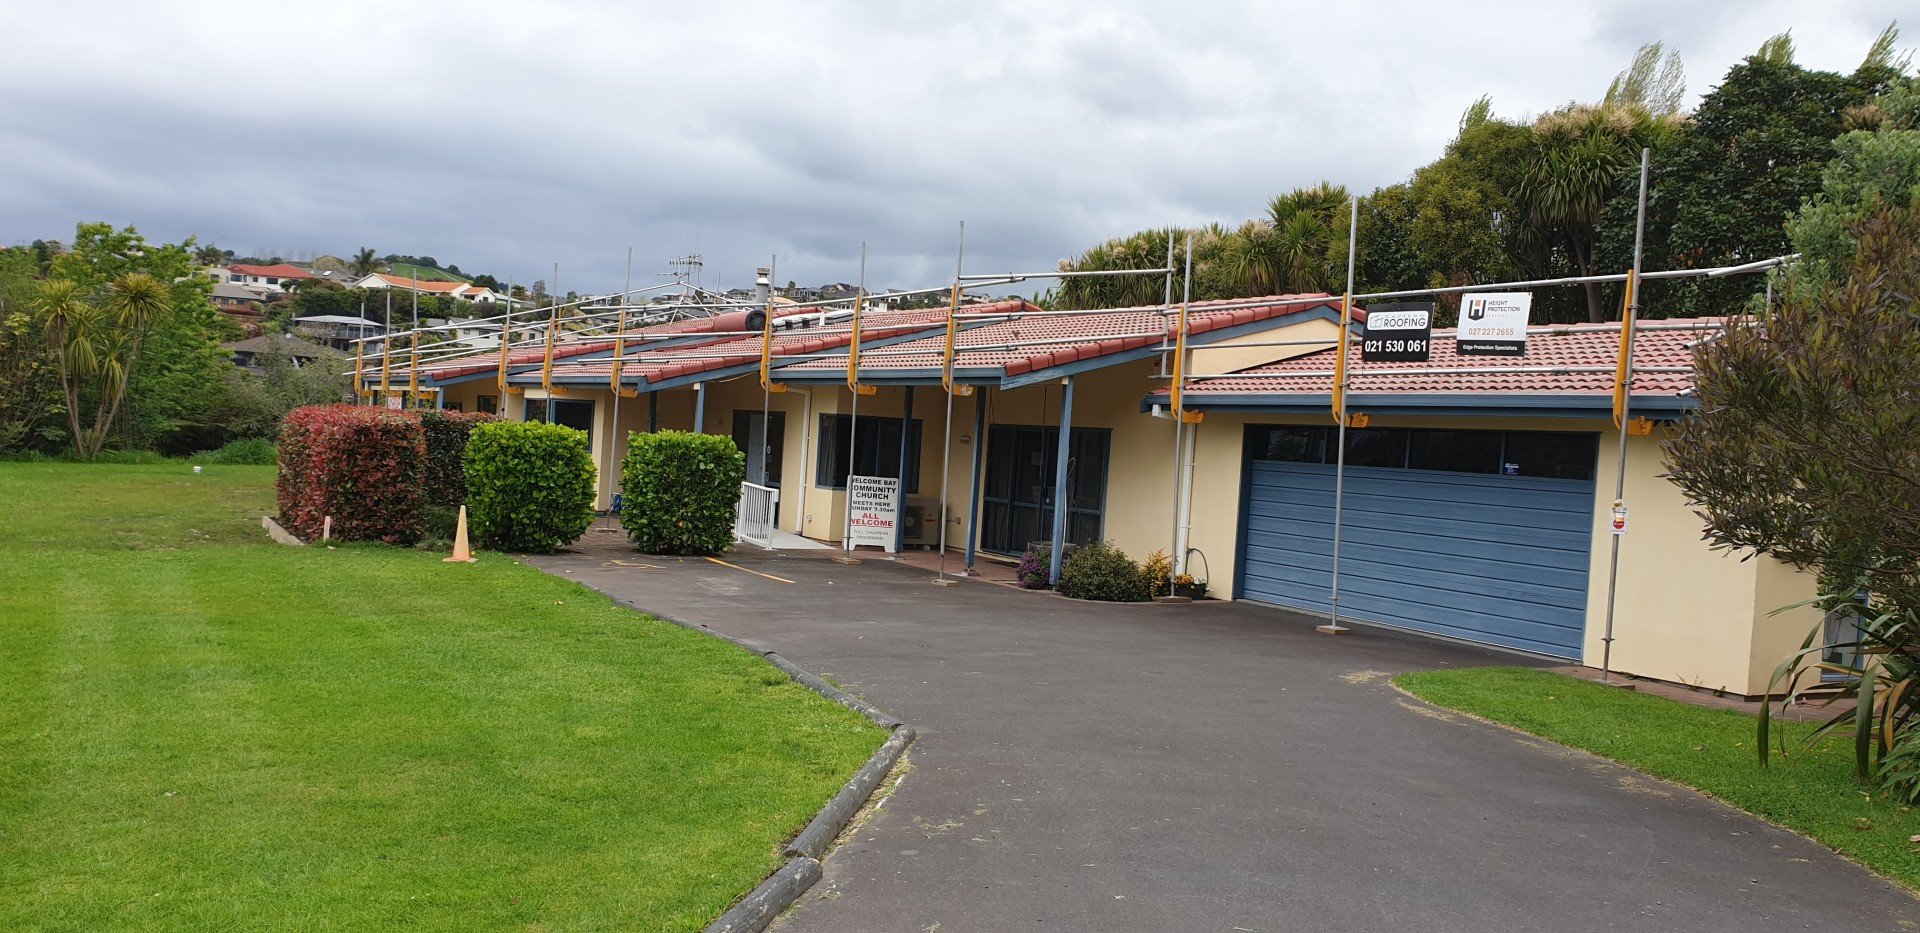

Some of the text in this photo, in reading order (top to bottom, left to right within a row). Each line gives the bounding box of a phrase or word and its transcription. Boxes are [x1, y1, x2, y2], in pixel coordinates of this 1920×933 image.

[1384, 318, 1426, 327] ROOFING
[1365, 340, 1427, 352] 021 530 061
[853, 485, 897, 494] OMMUNITY
[856, 491, 889, 500] CHURCH
